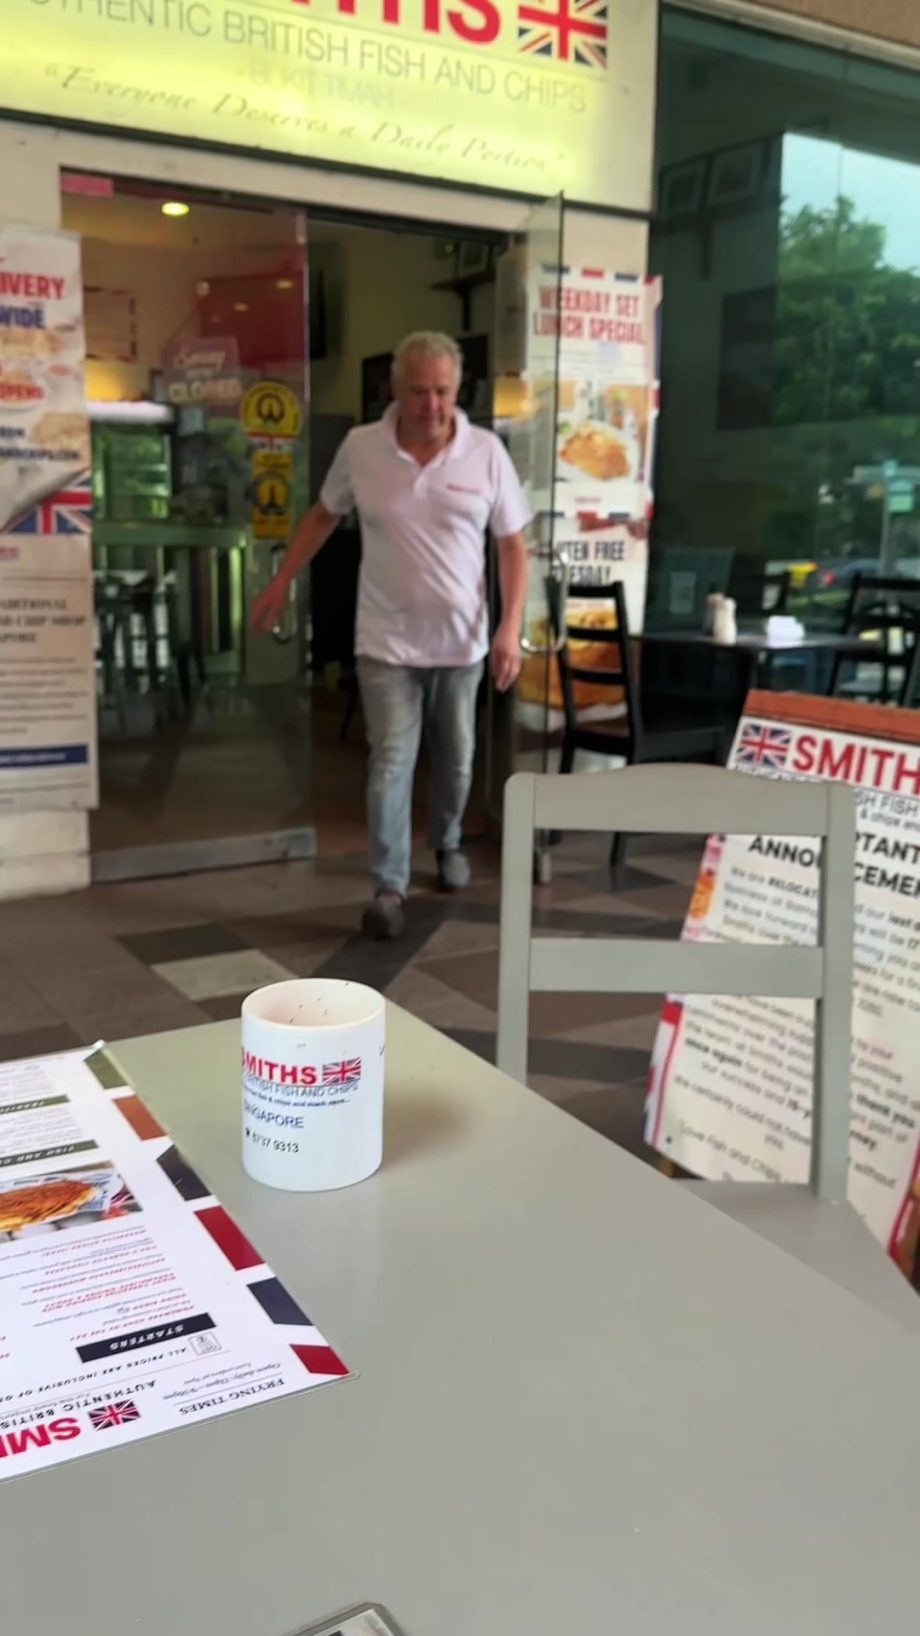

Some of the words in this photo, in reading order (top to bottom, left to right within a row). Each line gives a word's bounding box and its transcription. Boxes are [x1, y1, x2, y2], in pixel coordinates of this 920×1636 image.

[31, 0, 213, 38] HENTIC
[223, 10, 348, 64] BRITISH
[359, 40, 426, 82] FISH
[434, 56, 496, 96] AND
[503, 71, 587, 114] CHIPS
[339, 124, 355, 139] a
[538, 286, 610, 315] WEEKDAY
[616, 294, 641, 317] SET
[533, 312, 583, 339] LUNCH
[590, 317, 646, 346] SPECIAL
[595, 540, 625, 561] FREE
[792, 734, 920, 798] SMITH
[880, 795, 919, 817] FISH
[108, 1323, 185, 1351] STARTERS
[126, 1353, 165, 1369] PRICES
[168, 1347, 187, 1358] ALL
[102, 1365, 123, 1377] ARE
[18, 1389, 34, 1398] OF
[37, 1371, 98, 1394] INCLUSIVE
[229, 1378, 286, 1401] FRYING
[62, 1380, 156, 1412] AUTHENTIC
[178, 1396, 228, 1415] TIMES
